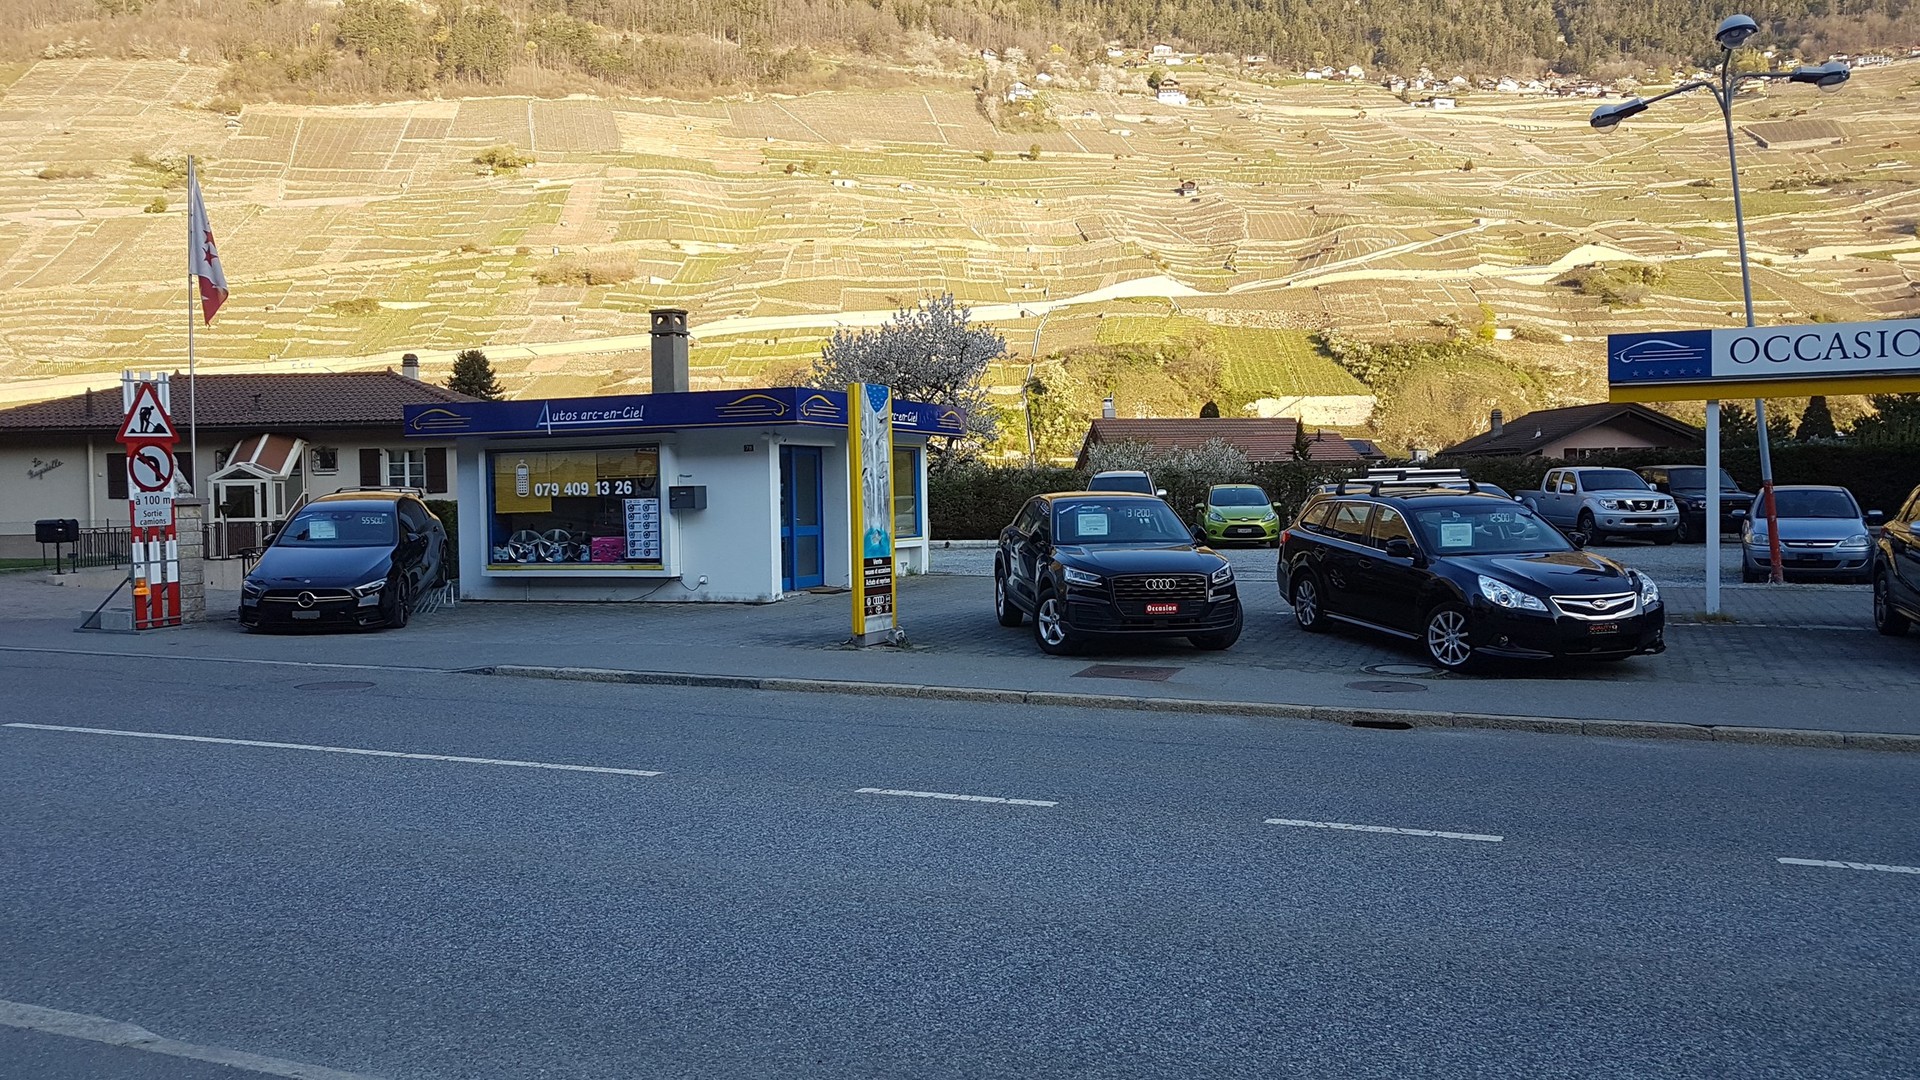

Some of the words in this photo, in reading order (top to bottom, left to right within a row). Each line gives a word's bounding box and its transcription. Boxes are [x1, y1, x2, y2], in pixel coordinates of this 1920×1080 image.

[1730, 329, 1920, 364] OCCASIO
[536, 401, 578, 434] Autos
[581, 405, 644, 420] arc-en-Ciel
[534, 483, 559, 497] 079
[563, 482, 589, 496] 409
[594, 481, 610, 495] 13
[614, 480, 632, 495] 26
[136, 496, 141, 505] à
[144, 495, 160, 505] 100
[140, 517, 166, 525] camions
[1147, 604, 1177, 612] Occasion
